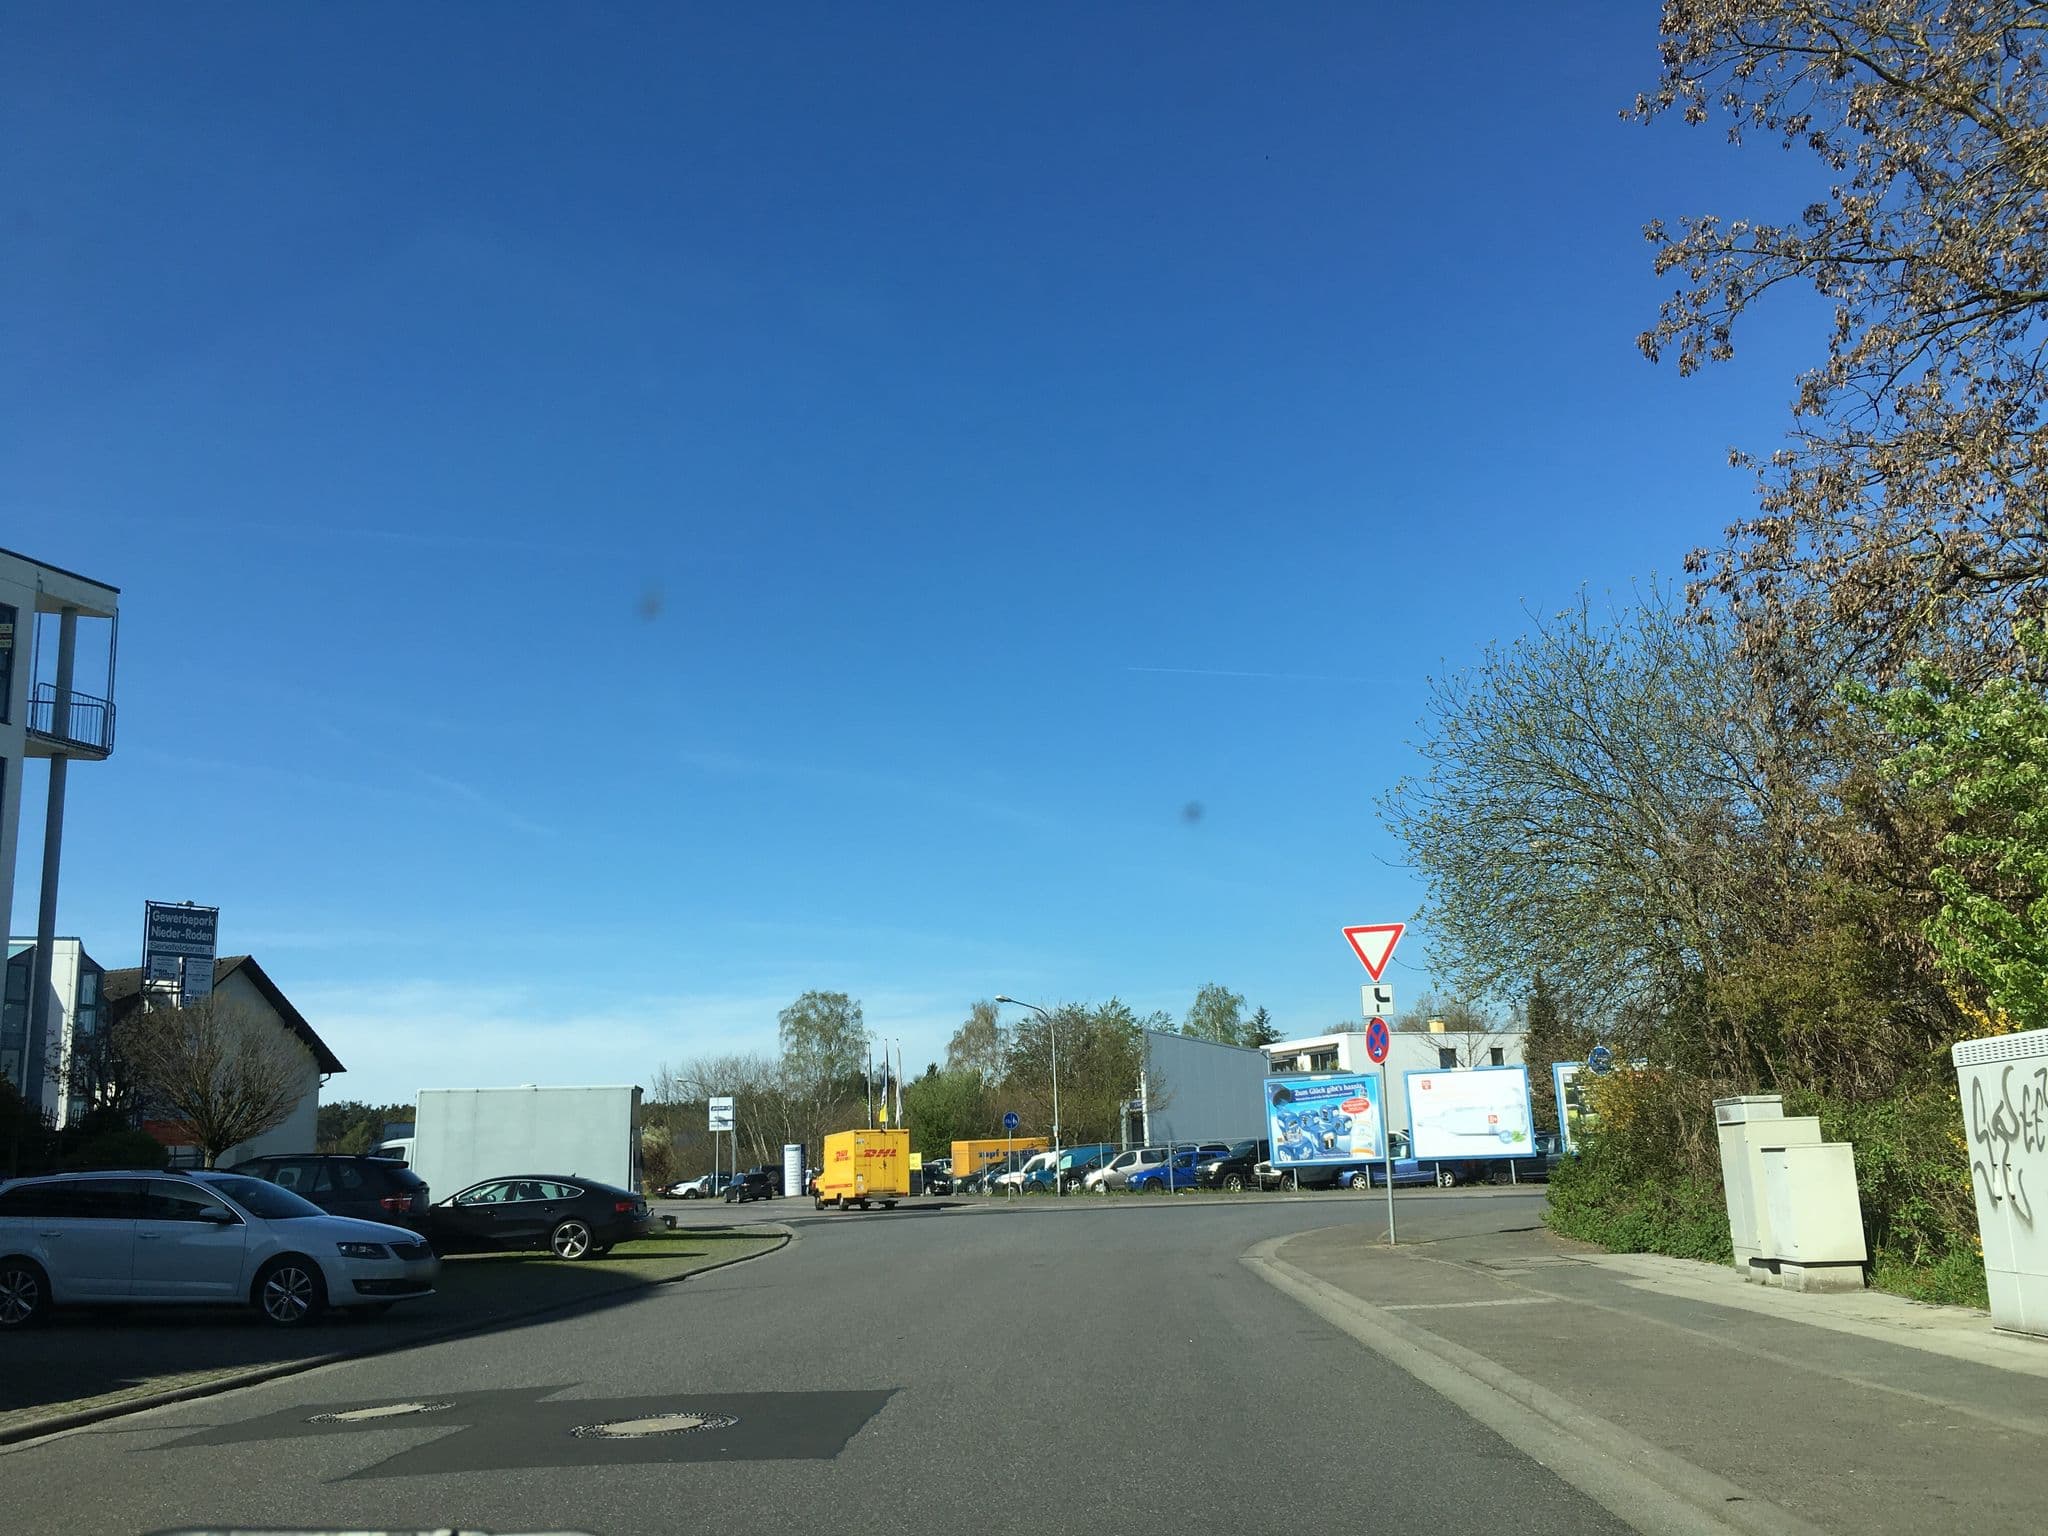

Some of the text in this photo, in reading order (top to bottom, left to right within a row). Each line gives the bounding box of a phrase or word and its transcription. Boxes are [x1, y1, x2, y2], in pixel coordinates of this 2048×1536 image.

[152, 910, 214, 927] Gewerbepark
[151, 926, 213, 941] Nieder-Roden
[1295, 1089, 1308, 1097] Zum
[1309, 1087, 1326, 1096] Glück
[864, 1149, 897, 1158] DHL
